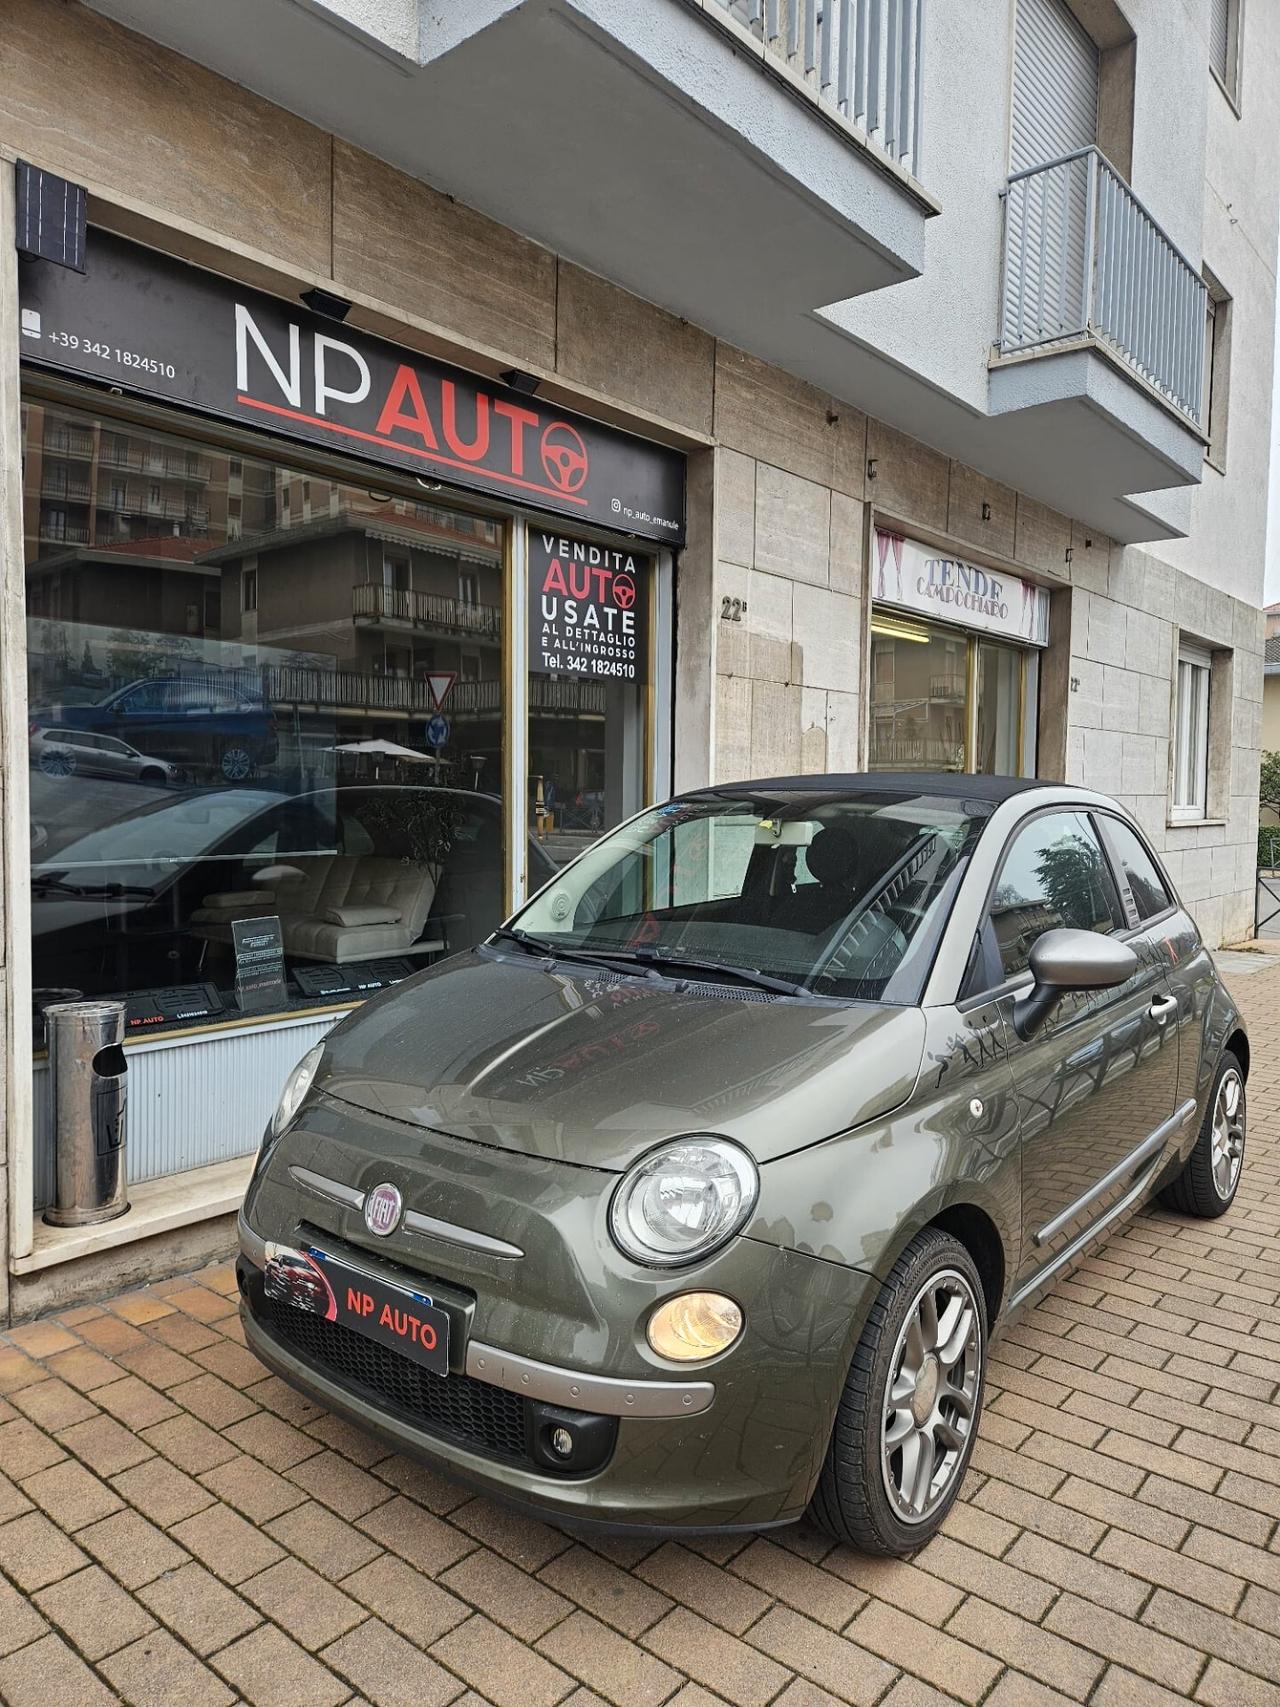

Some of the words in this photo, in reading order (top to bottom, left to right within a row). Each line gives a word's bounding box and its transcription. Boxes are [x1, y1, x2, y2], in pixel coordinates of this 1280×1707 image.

[48, 332, 79, 349] +39
[82, 339, 111, 360] 342
[115, 349, 175, 379] 1824510
[542, 534, 636, 574] VENDITA
[542, 558, 636, 609] AUTO
[924, 558, 1004, 602] TENDE
[541, 594, 635, 634] USATE
[542, 622, 559, 635] AL
[565, 625, 635, 647] DETTAGLIO
[542, 636, 548, 646] E
[553, 638, 635, 660] ALL'INGROSSO
[542, 652, 563, 669] Tel.
[566, 655, 588, 672] 342
[591, 658, 635, 678] 1824510
[347, 1287, 375, 1318] NP
[379, 1303, 437, 1350] AUTO
